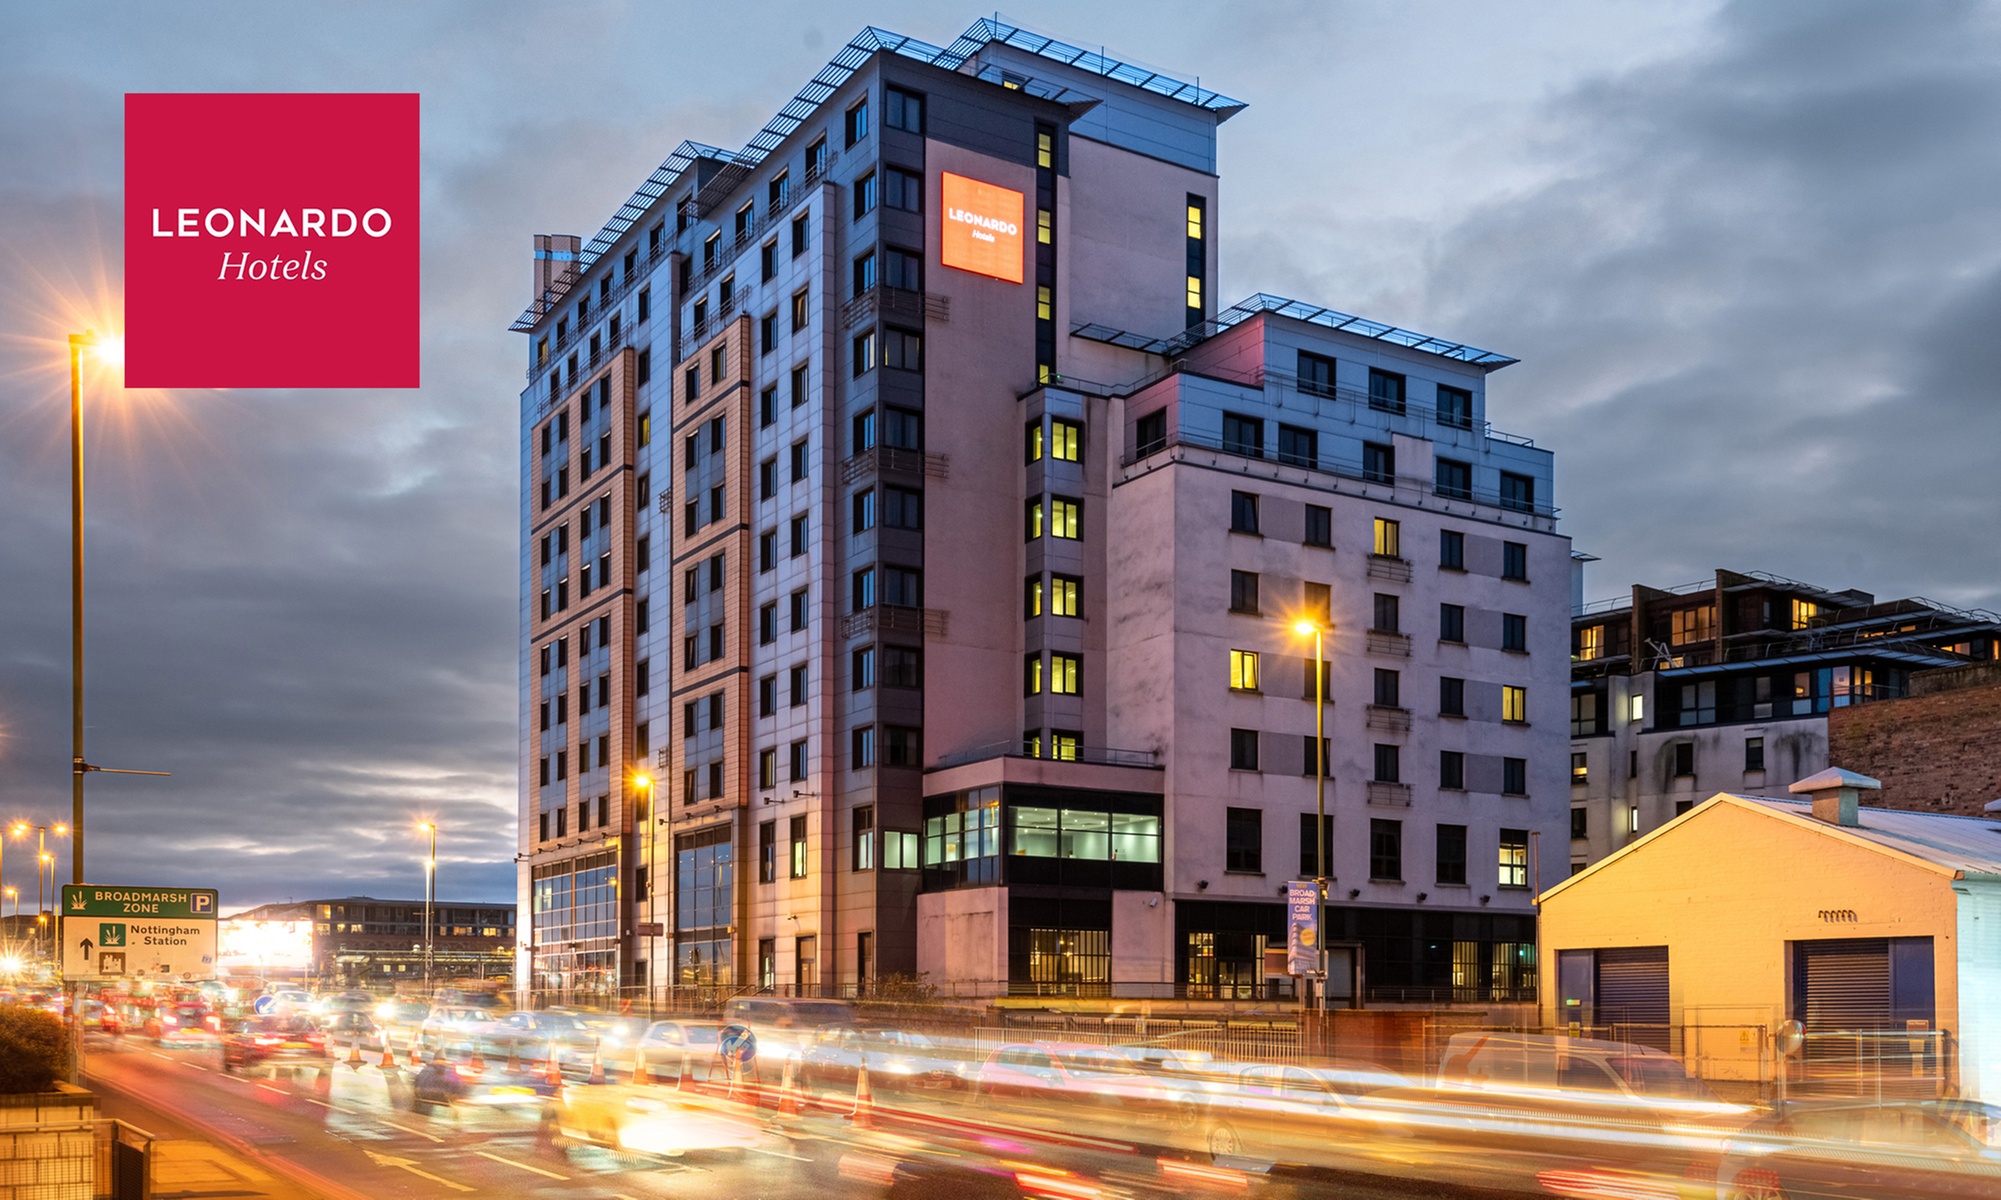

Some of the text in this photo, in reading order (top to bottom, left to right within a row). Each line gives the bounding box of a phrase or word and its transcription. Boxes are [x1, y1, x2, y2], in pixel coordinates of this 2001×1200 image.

[949, 207, 1017, 236] LEONARDO
[972, 229, 995, 243] Hotels
[95, 891, 187, 903] BROADMARSH
[1289, 897, 1315, 905] MARSH
[123, 903, 159, 913] ZONE
[196, 895, 210, 911] P
[1292, 913, 1312, 921] PARK
[130, 925, 200, 936] Nottingham
[144, 936, 187, 945] Station
